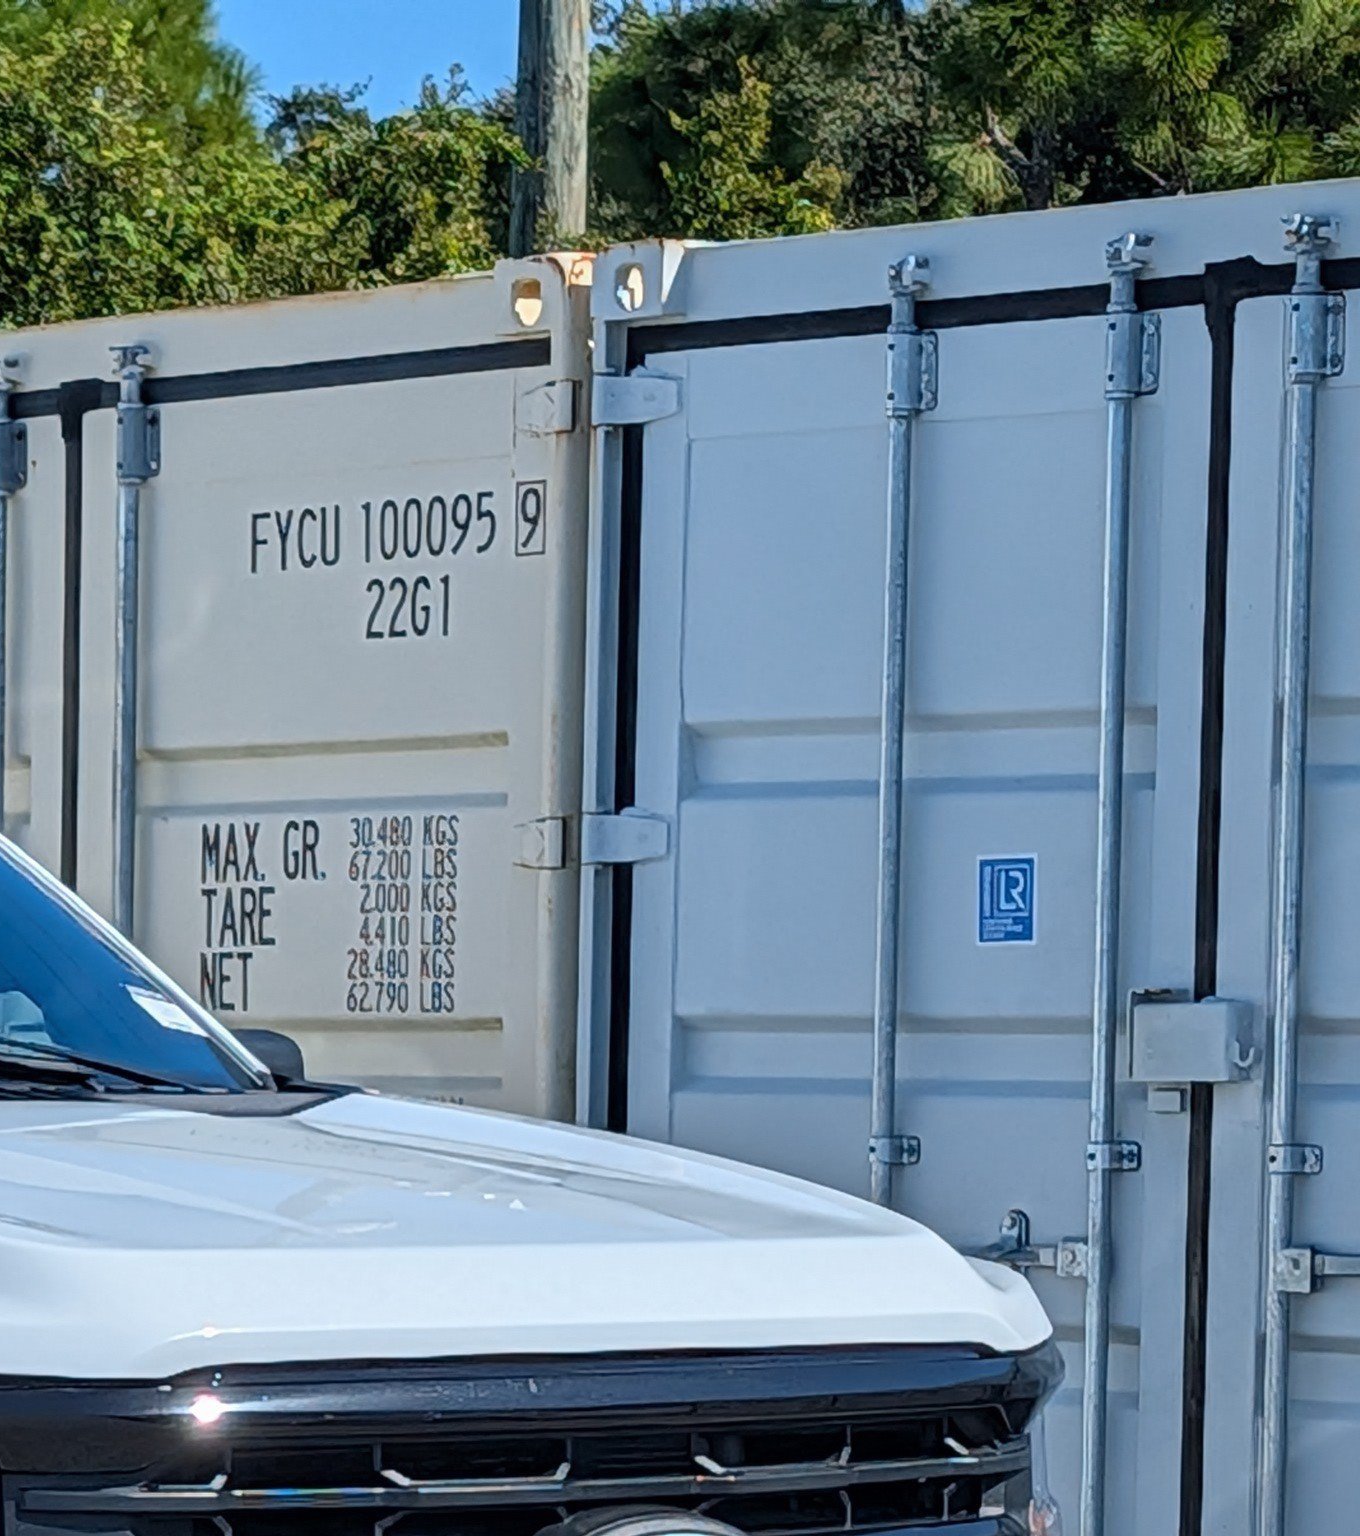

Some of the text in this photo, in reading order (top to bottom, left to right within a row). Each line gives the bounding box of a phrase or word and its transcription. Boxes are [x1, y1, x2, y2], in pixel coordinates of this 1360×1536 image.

[250, 486, 543, 574] FYCU 100095 9
[365, 573, 450, 640] 22G1
[200, 819, 328, 885] MAX. GR.
[348, 813, 460, 849] 30.480 KGS
[421, 847, 458, 880] LBS
[200, 885, 277, 948] TARE
[421, 880, 458, 913] KGS
[420, 914, 458, 946] LBS
[199, 951, 254, 1013] NET
[420, 947, 456, 979] KGS
[419, 980, 456, 1014] LBS
